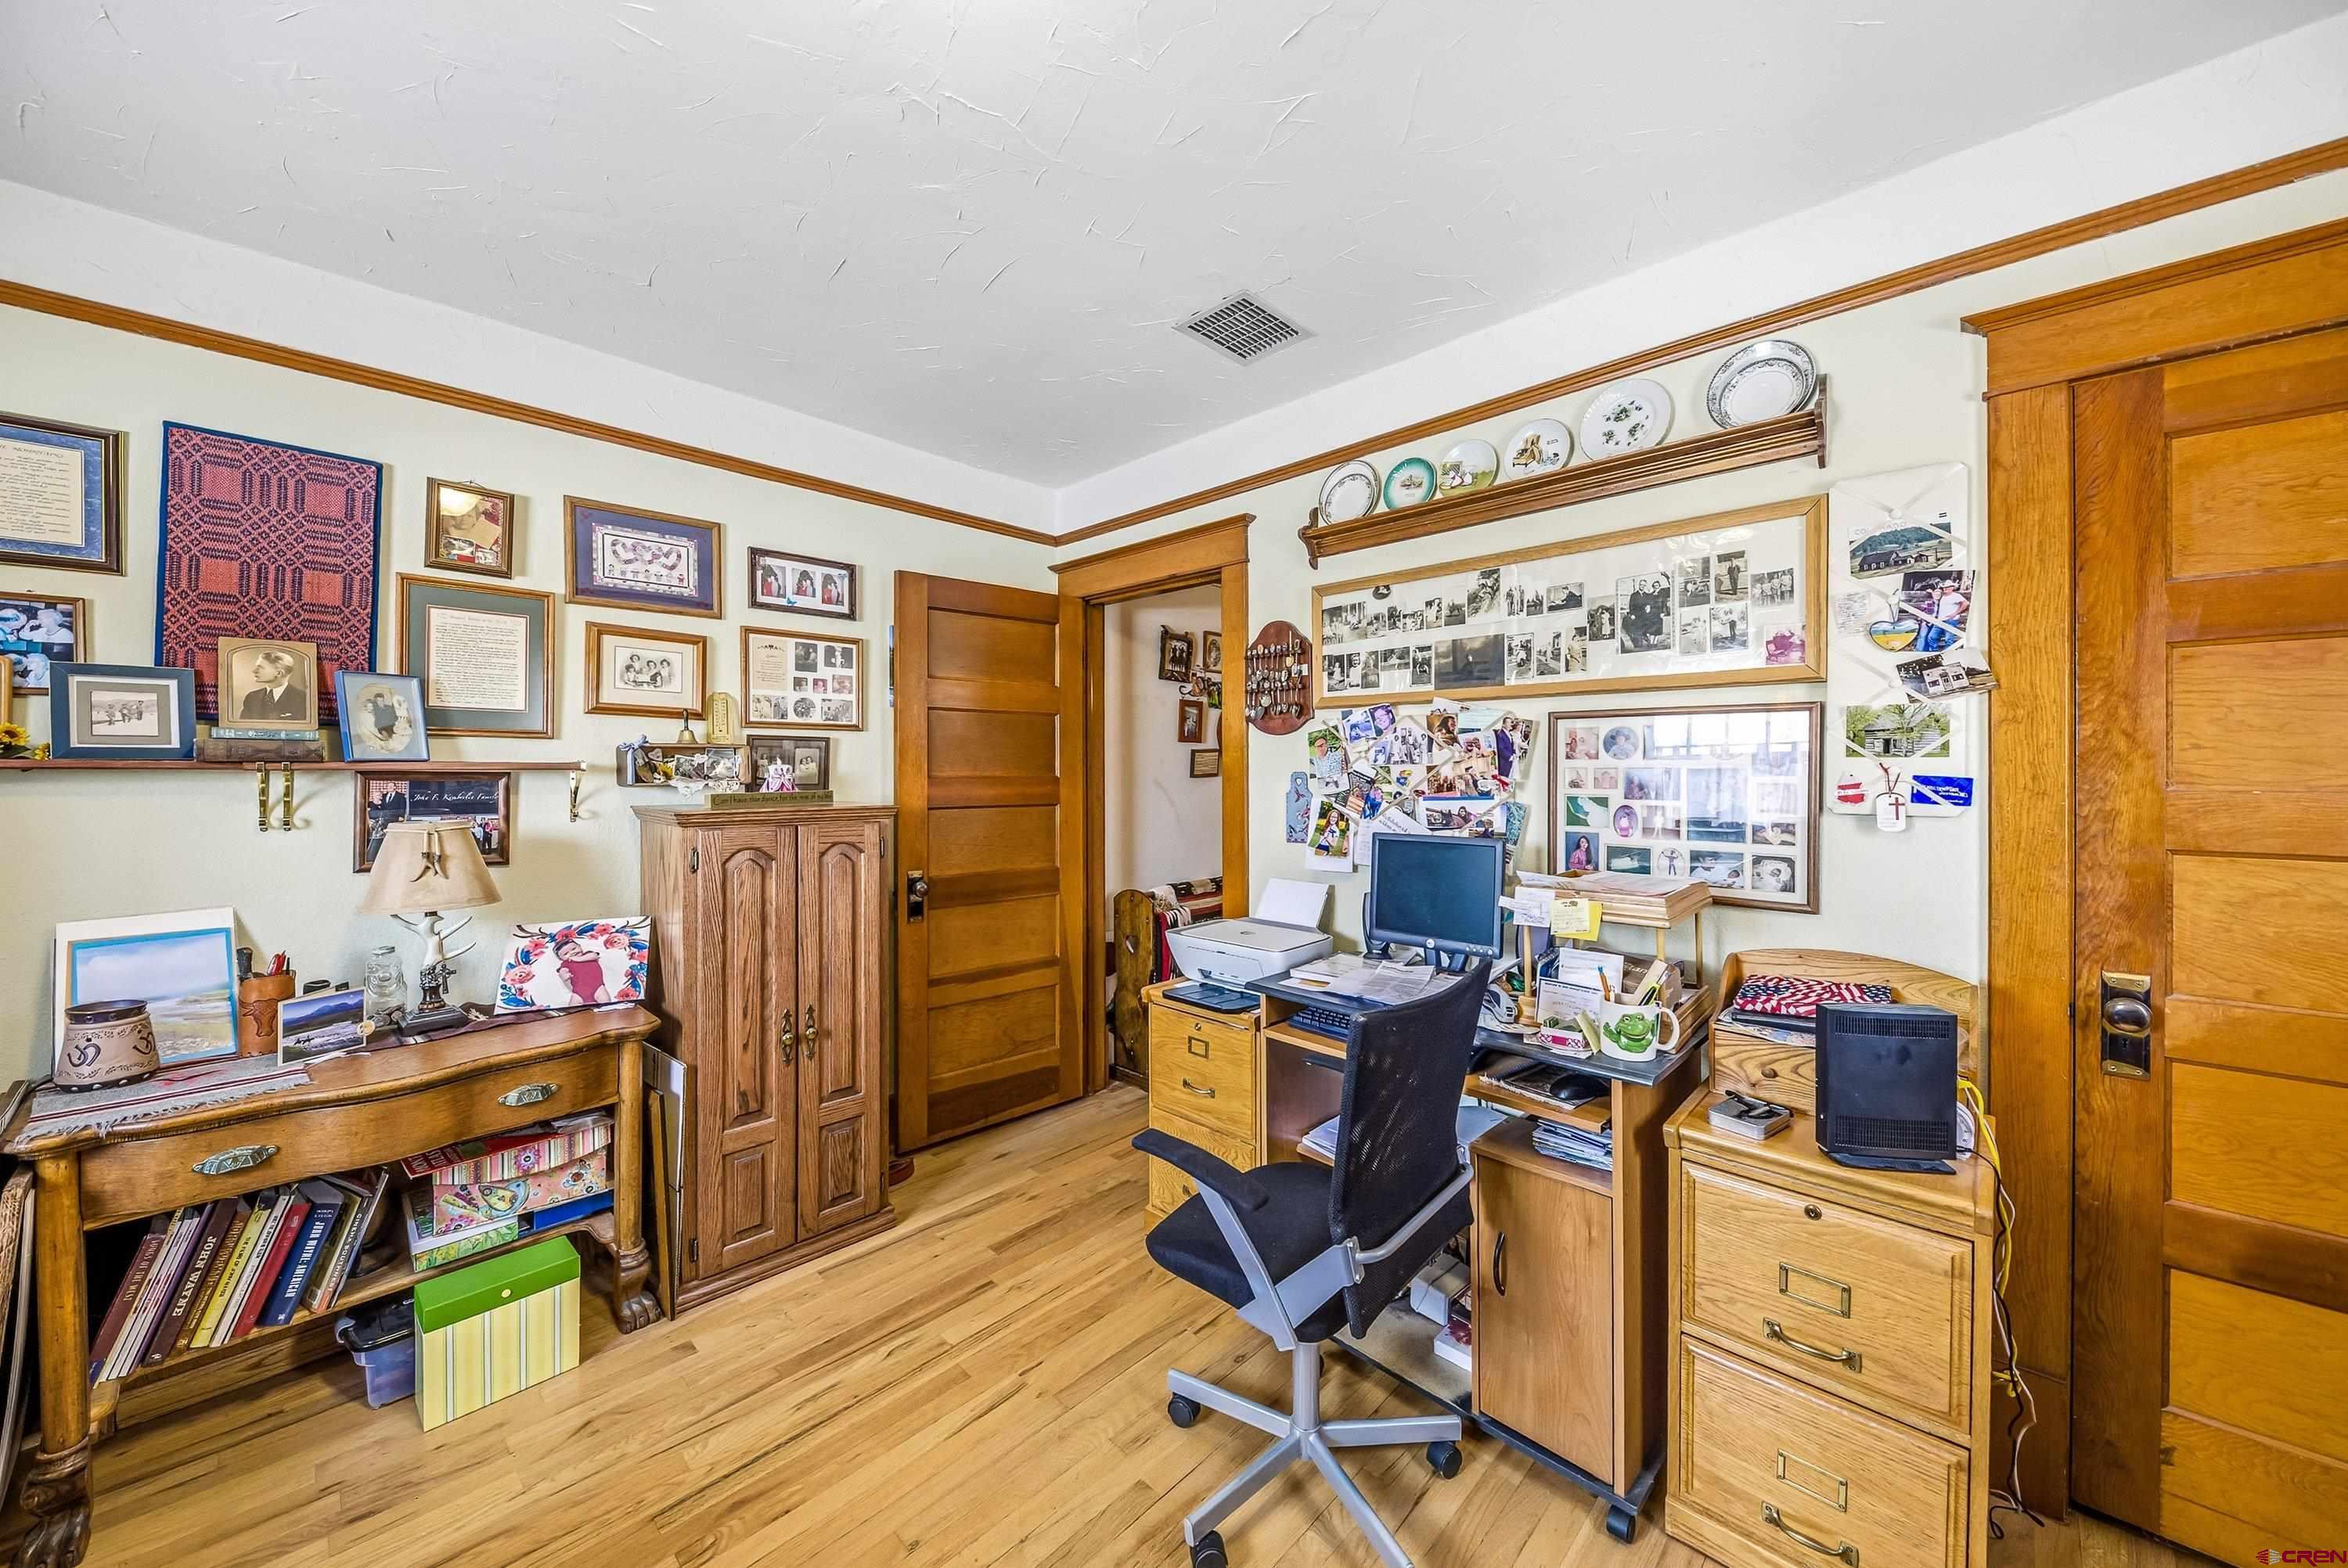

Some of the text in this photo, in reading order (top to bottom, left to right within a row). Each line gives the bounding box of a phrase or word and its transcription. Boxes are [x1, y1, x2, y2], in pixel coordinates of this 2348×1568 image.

[310, 1219, 326, 1242] JOHN
[143, 1238, 160, 1261] SONGS
[194, 1235, 217, 1271] JOHN
[122, 1283, 138, 1304] WEST
[172, 1267, 202, 1317] WAYNE
